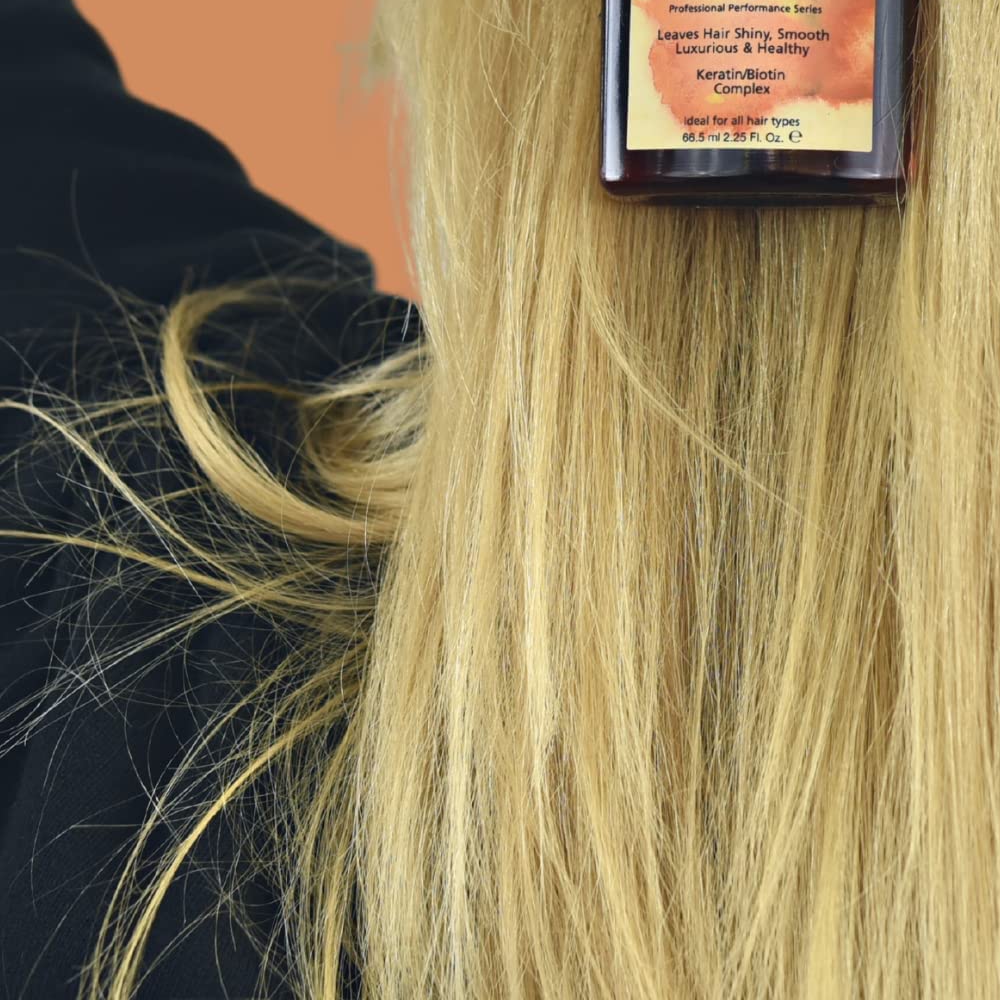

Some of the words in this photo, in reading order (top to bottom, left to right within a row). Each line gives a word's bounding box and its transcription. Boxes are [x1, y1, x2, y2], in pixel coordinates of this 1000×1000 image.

[669, 4, 725, 14] Professional
[728, 4, 791, 14] Performance
[794, 5, 822, 14] Series
[658, 29, 699, 40] Leaves
[703, 29, 730, 39] Hair
[734, 28, 772, 41] Shiny,
[778, 29, 829, 41] Smooth
[675, 43, 738, 54] Luxurious
[743, 44, 752, 54] &
[757, 43, 810, 57] Healthy
[696, 69, 785, 81] Keratin/Biotin
[714, 83, 770, 96] Complex
[713, 116, 728, 126] for
[731, 116, 744, 126] all
[747, 116, 768, 126] hair
[771, 118, 800, 128] types
[682, 133, 705, 143] 66.5
[708, 133, 720, 142] ml
[723, 133, 746, 142] 2.25
[766, 133, 784, 143] Oz.
